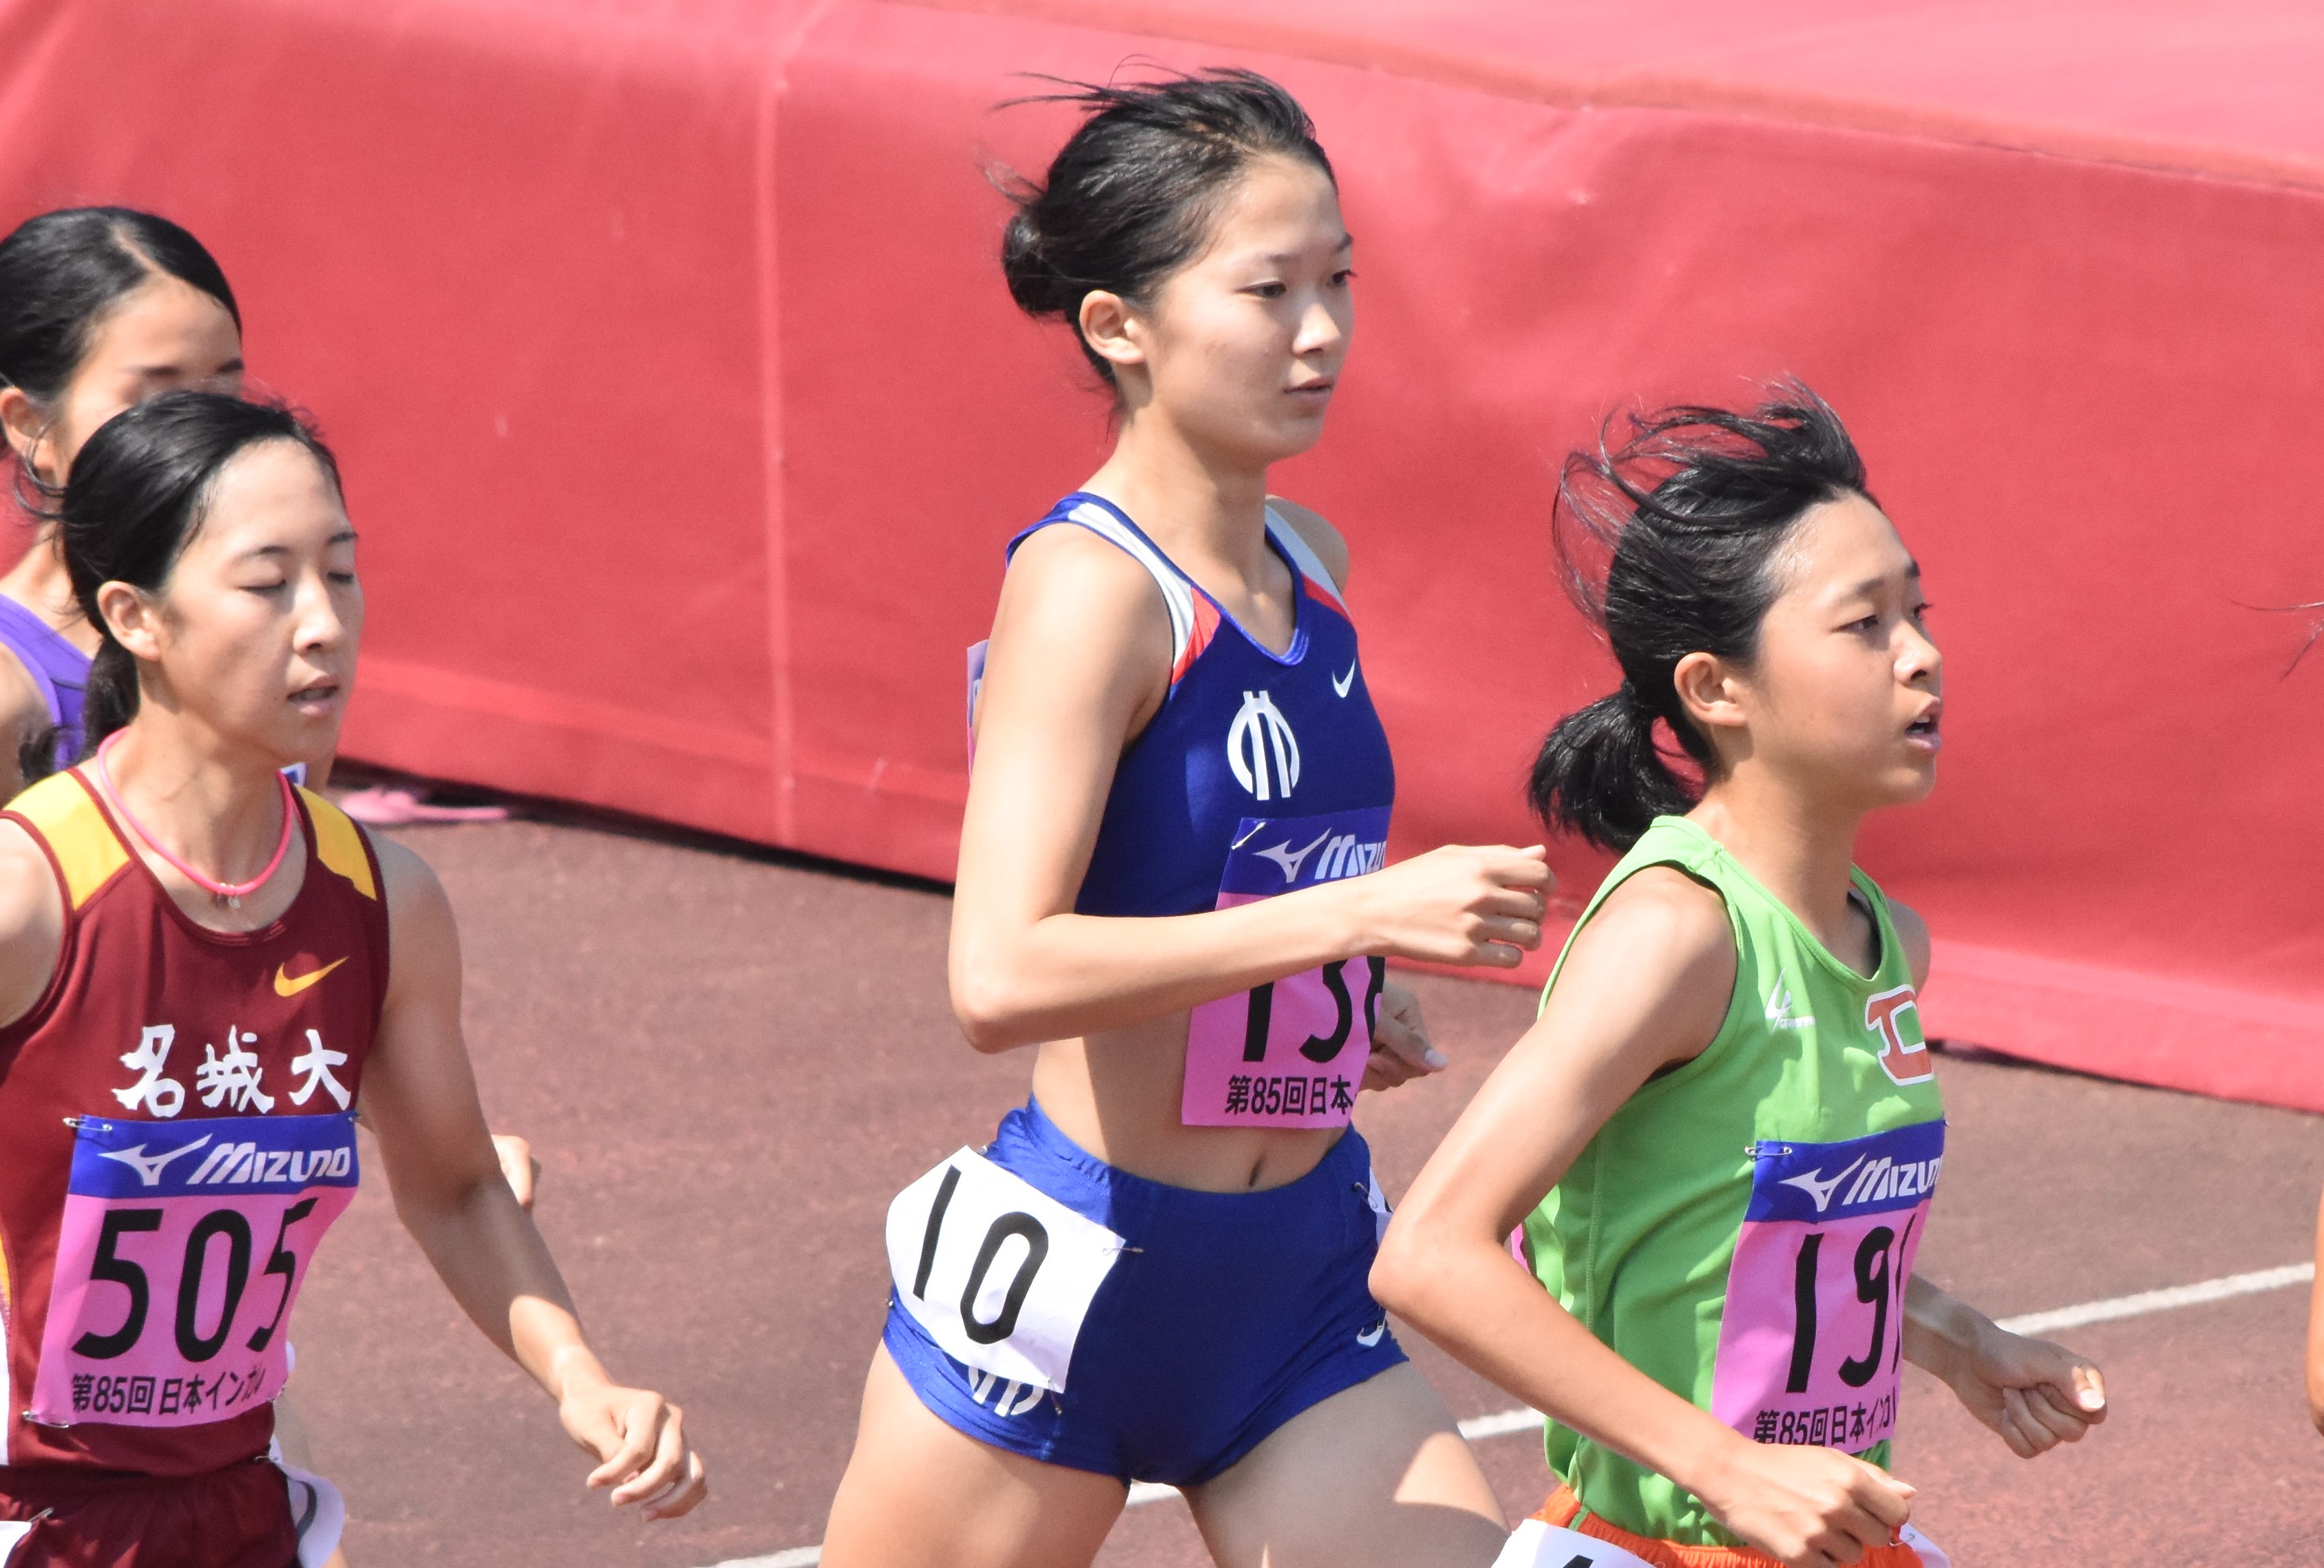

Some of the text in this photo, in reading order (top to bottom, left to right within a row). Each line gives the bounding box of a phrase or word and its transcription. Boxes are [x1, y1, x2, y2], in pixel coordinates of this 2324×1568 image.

[112, 1024, 352, 1118] 名城大
[1225, 1074, 1357, 1116] 第85回日本
[1842, 1155, 1943, 1205] MIZUN
[71, 1197, 318, 1363] 505
[913, 1165, 1049, 1345] 10
[1786, 1213, 1917, 1393] 19
